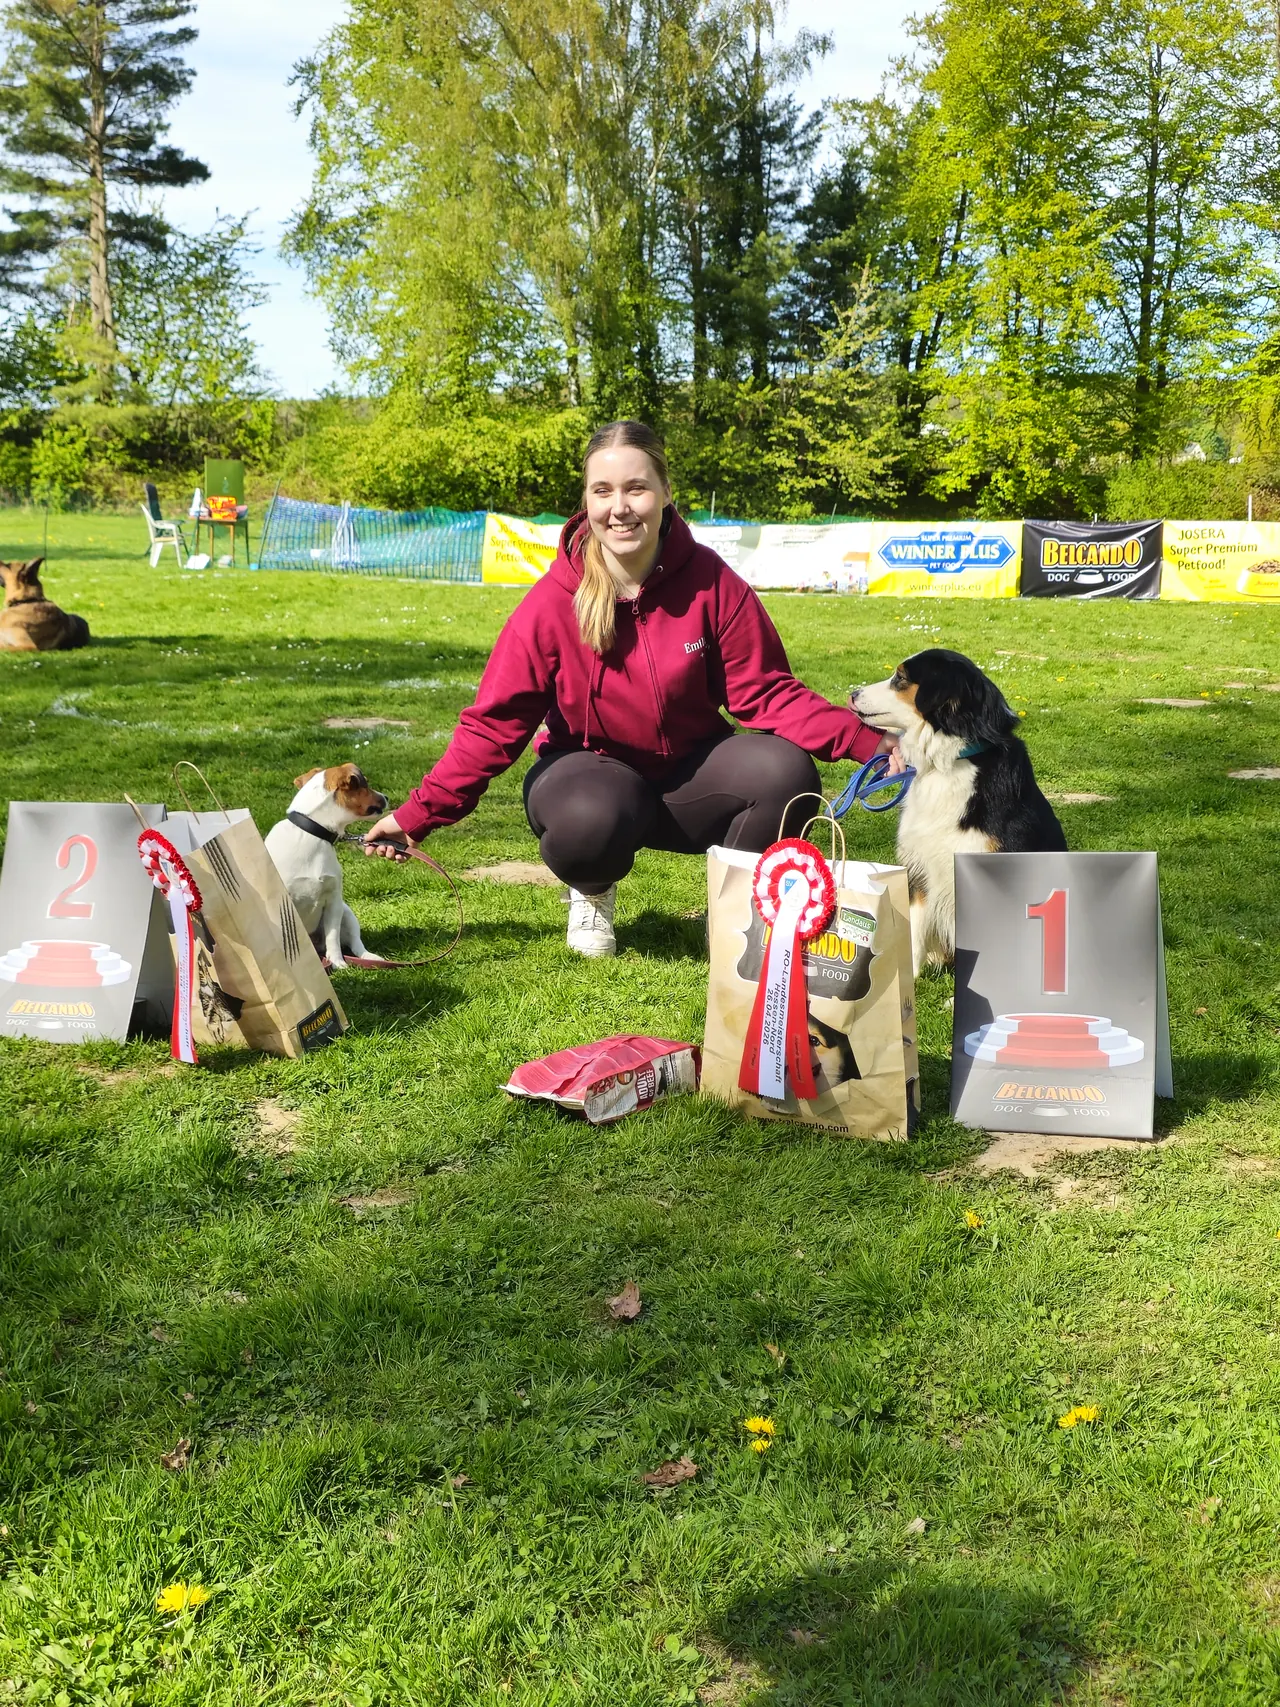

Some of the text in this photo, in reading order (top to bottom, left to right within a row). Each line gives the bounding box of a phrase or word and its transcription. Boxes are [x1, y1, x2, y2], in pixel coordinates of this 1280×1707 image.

[920, 534, 972, 542] SUPER PREMIUM
[1178, 528, 1226, 541] JOSERA
[890, 543, 1000, 560] WINNER PLUS
[1041, 538, 1142, 568] BELCANDO
[1169, 542, 1258, 558] Super Premium
[1177, 559, 1226, 571] Petfood!
[1047, 573, 1070, 582] DOG
[909, 582, 982, 593] winnerplus.eu
[46, 834, 99, 920] 2
[1026, 888, 1070, 996] 1
[821, 968, 850, 982] FOOD
[7, 999, 95, 1018] BELCANDO
[763, 989, 774, 1046] 26.04.2026
[775, 949, 791, 1084] RO-Landesmeisterschaft
[67, 1021, 96, 1029] FOOD
[769, 982, 780, 1055] Hessen-Nord
[637, 1071, 648, 1100] ADULT
[646, 1068, 656, 1089] BEEF
[992, 1082, 1106, 1104] BELCANDO
[994, 1104, 1110, 1117] DOG FOOD
